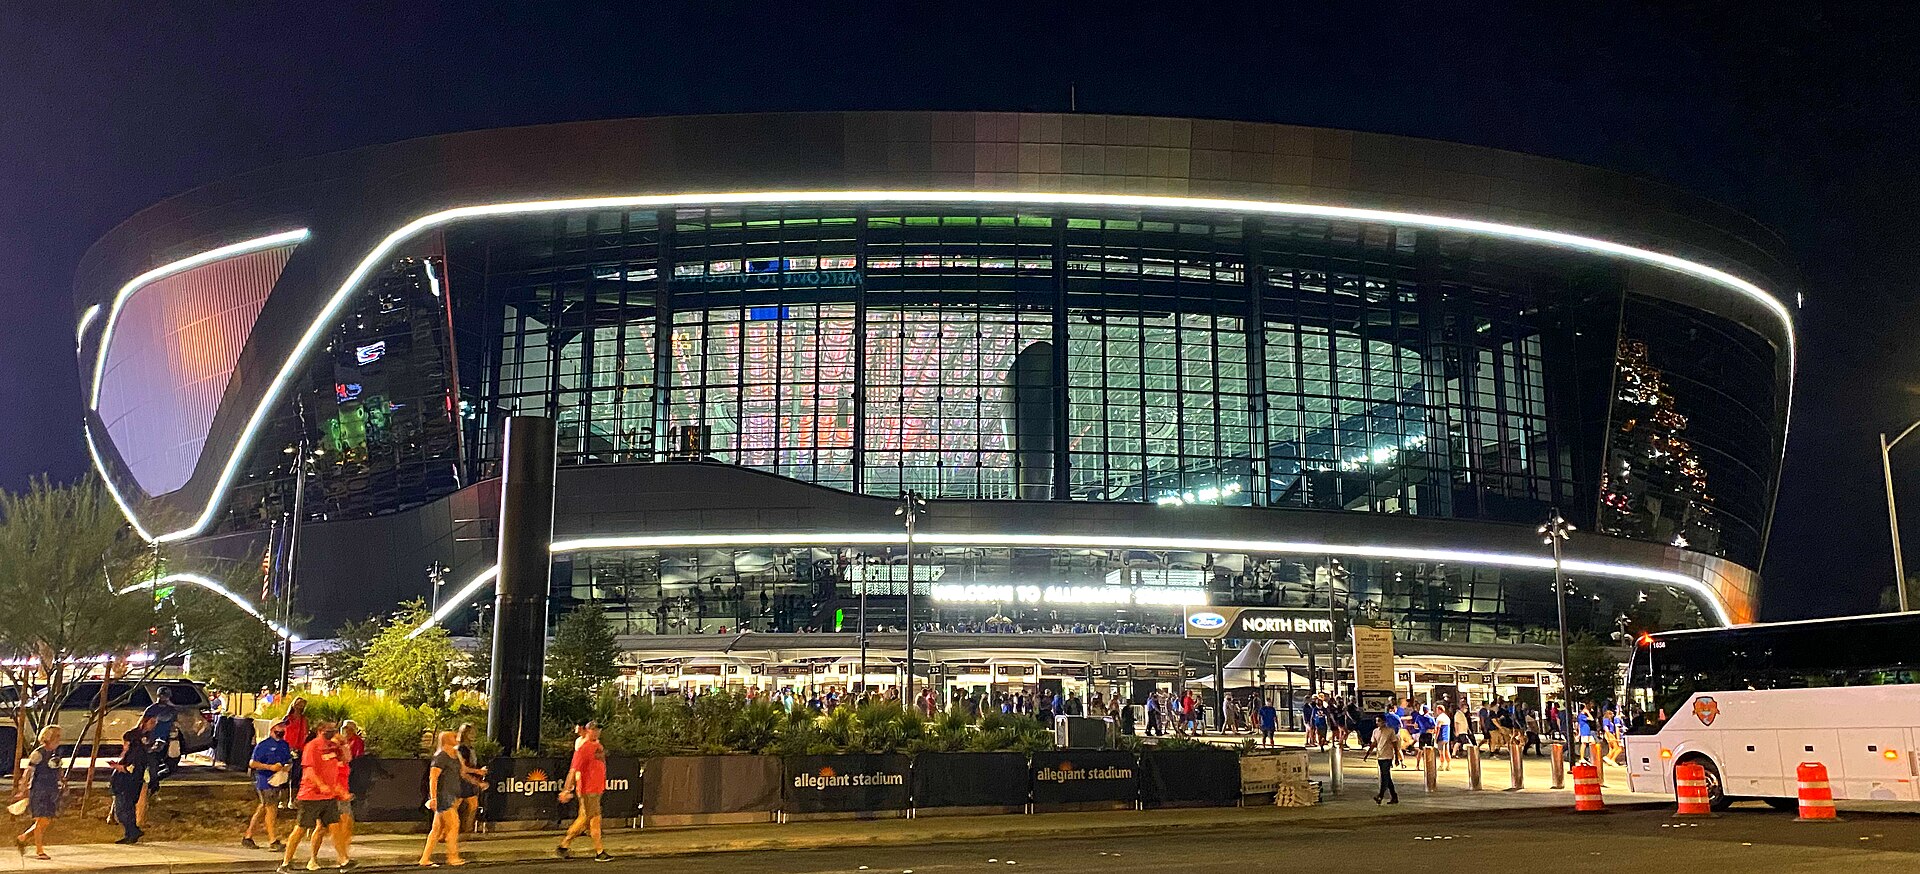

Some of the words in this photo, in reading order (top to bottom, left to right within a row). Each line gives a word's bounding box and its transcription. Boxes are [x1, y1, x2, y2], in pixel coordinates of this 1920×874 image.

[1016, 584, 1042, 602] TO
[1242, 617, 1293, 632] NORTH
[931, 665, 940, 673] 32
[794, 773, 850, 790] allegiant
[852, 771, 903, 786] stadium
[1037, 767, 1086, 783] allegiant
[1087, 765, 1132, 779] stadium
[496, 777, 566, 796] allegiant
